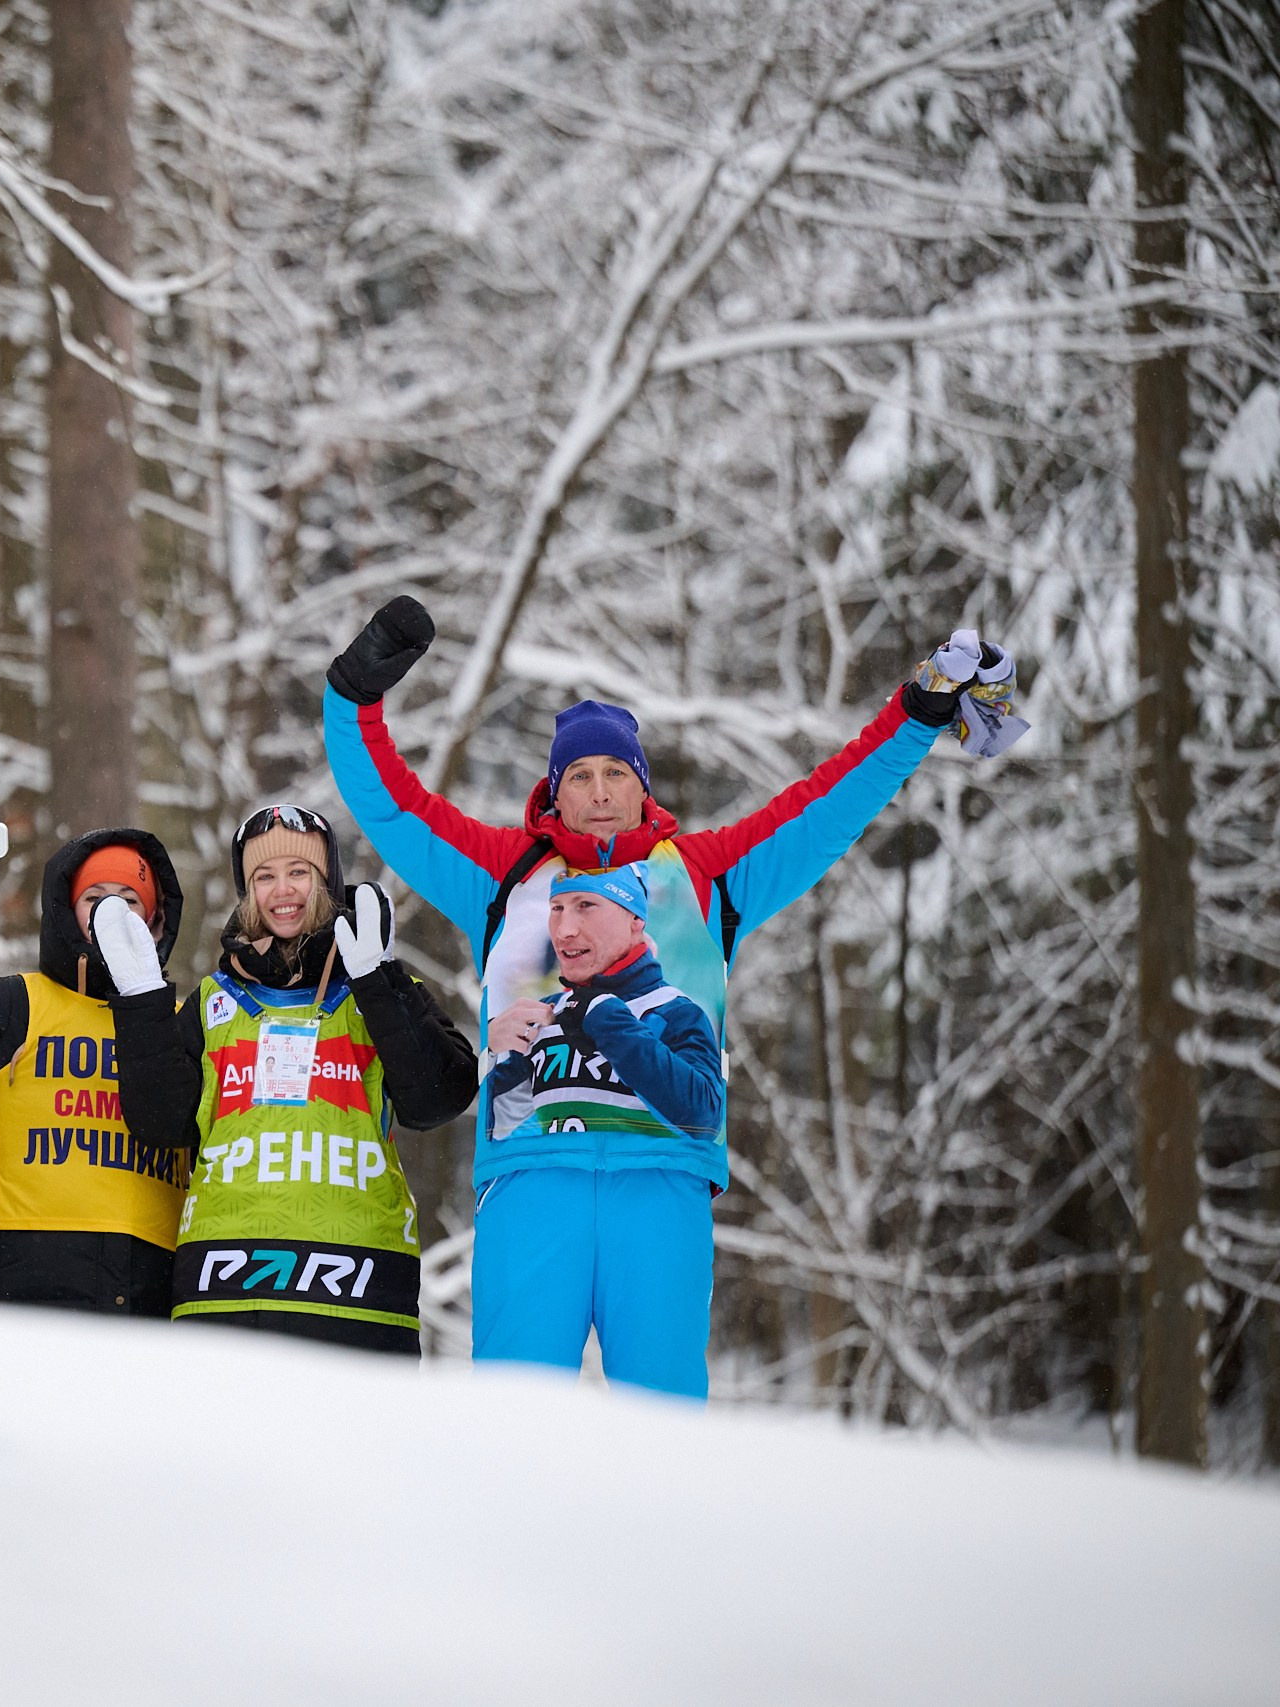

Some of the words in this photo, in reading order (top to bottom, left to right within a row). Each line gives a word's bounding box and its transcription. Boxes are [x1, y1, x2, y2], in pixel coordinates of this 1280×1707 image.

[34, 1036, 120, 1081] ПОВ
[54, 1088, 122, 1122] САМ
[202, 1131, 387, 1192] ТРЕНЕР
[198, 1249, 375, 1298] PARI
